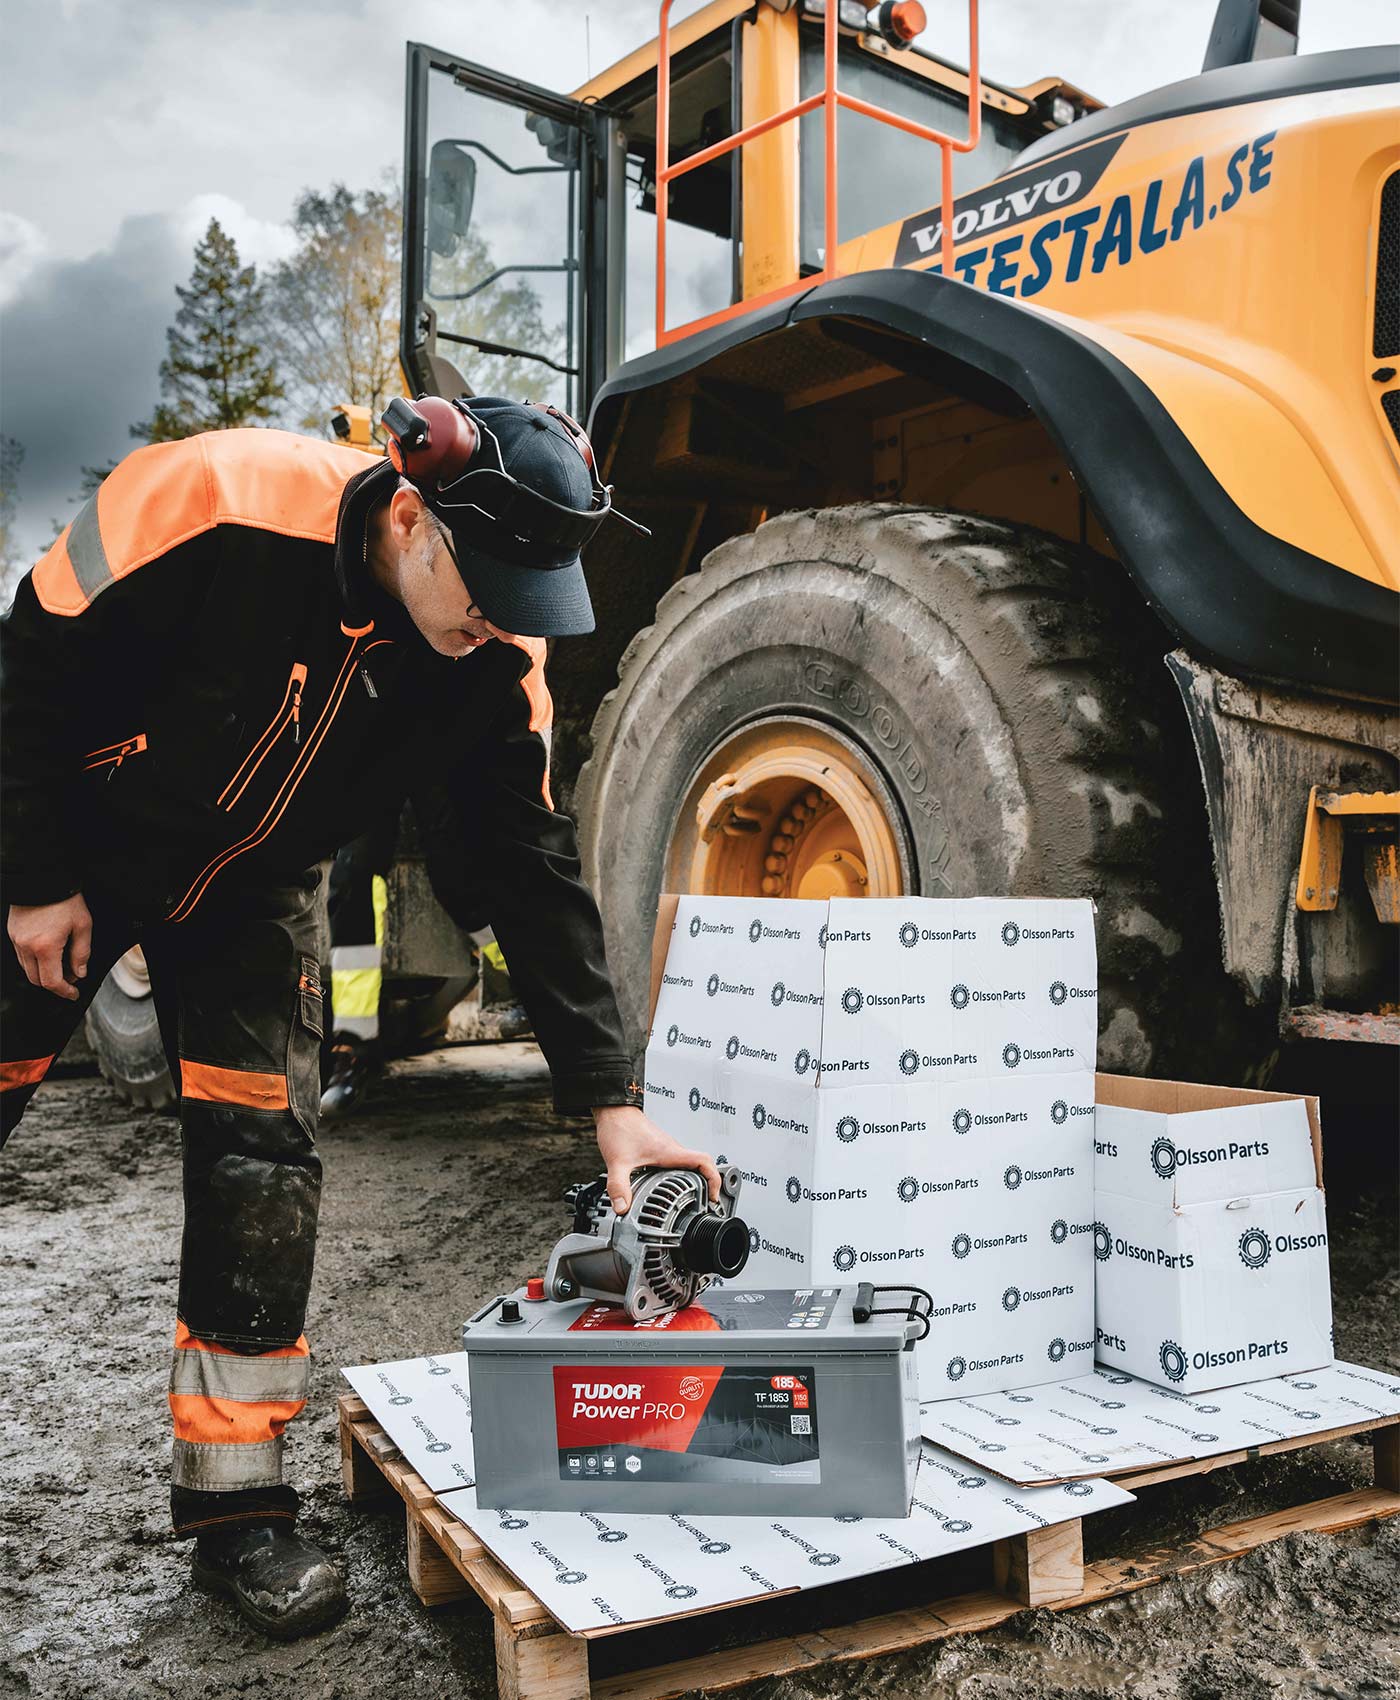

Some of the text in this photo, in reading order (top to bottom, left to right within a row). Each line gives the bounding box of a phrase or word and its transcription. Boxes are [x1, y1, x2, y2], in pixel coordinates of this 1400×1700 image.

[912, 170, 1082, 254] VOLVO
[924, 130, 1277, 298] TESTALA.SE
[702, 922, 734, 934] Olsson Parts
[763, 927, 800, 940] Olsson Parts
[845, 930, 871, 941] Parts
[922, 930, 976, 940] Olsson Parts
[1022, 929, 1074, 939] Olsson Parts
[663, 974, 693, 987] Olsson Parts
[720, 982, 755, 996] Olsson Parts
[972, 991, 1025, 1001] Olsson Parts
[786, 991, 807, 1003] Olsson
[866, 994, 925, 1006] Olsson Parts
[679, 1033, 712, 1048] Olsson Parts
[740, 1045, 777, 1062] Olsson Parts
[922, 1054, 977, 1066] Olsson Parts
[1023, 1048, 1074, 1060] Olsson Parts
[842, 1060, 869, 1070] Parts
[646, 1082, 675, 1098] Olsson Parts
[701, 1097, 736, 1115] Olsson Parts
[768, 1114, 808, 1135] Olsson Parts
[975, 1112, 1028, 1125] Olsson Parts
[863, 1121, 926, 1134] Olsson Parts
[1176, 1141, 1269, 1166] Olsson Parts
[751, 1172, 767, 1186] Parts
[1024, 1167, 1074, 1181] Olsson Parts
[922, 1179, 978, 1193] Olsson Parts
[803, 1188, 867, 1201] Olsson Parts
[974, 1234, 1028, 1249] Olsson Parts
[1275, 1233, 1326, 1253] Olsson
[762, 1239, 804, 1264] Olsson Parts
[860, 1248, 924, 1262] Olsson Parts
[1116, 1239, 1194, 1269] Olsson Parts
[1023, 1285, 1074, 1302] Olsson Parts
[930, 1302, 977, 1318] sson Parts
[1096, 1328, 1126, 1352] Parts
[969, 1353, 1023, 1371] Olsson Parts
[1194, 1339, 1288, 1370] Olsson Parts
[679, 1382, 704, 1396] QUALITY
[774, 1377, 794, 1388] 185
[572, 1384, 642, 1400] TUDOR
[755, 1393, 789, 1402] TF 1853
[572, 1403, 685, 1419] Power PRO
[936, 1463, 964, 1479] Olsson
[919, 1500, 949, 1521] Olsson
[1001, 1498, 1025, 1513] Parts
[686, 1524, 711, 1543] Olsson
[771, 1523, 818, 1554] Olsson Parts
[876, 1533, 898, 1548] Parts
[531, 1541, 568, 1571] Olsson Parts
[633, 1553, 676, 1586] Olsson Parts
[740, 1565, 759, 1581] Parts
[592, 1597, 614, 1615] Parts
